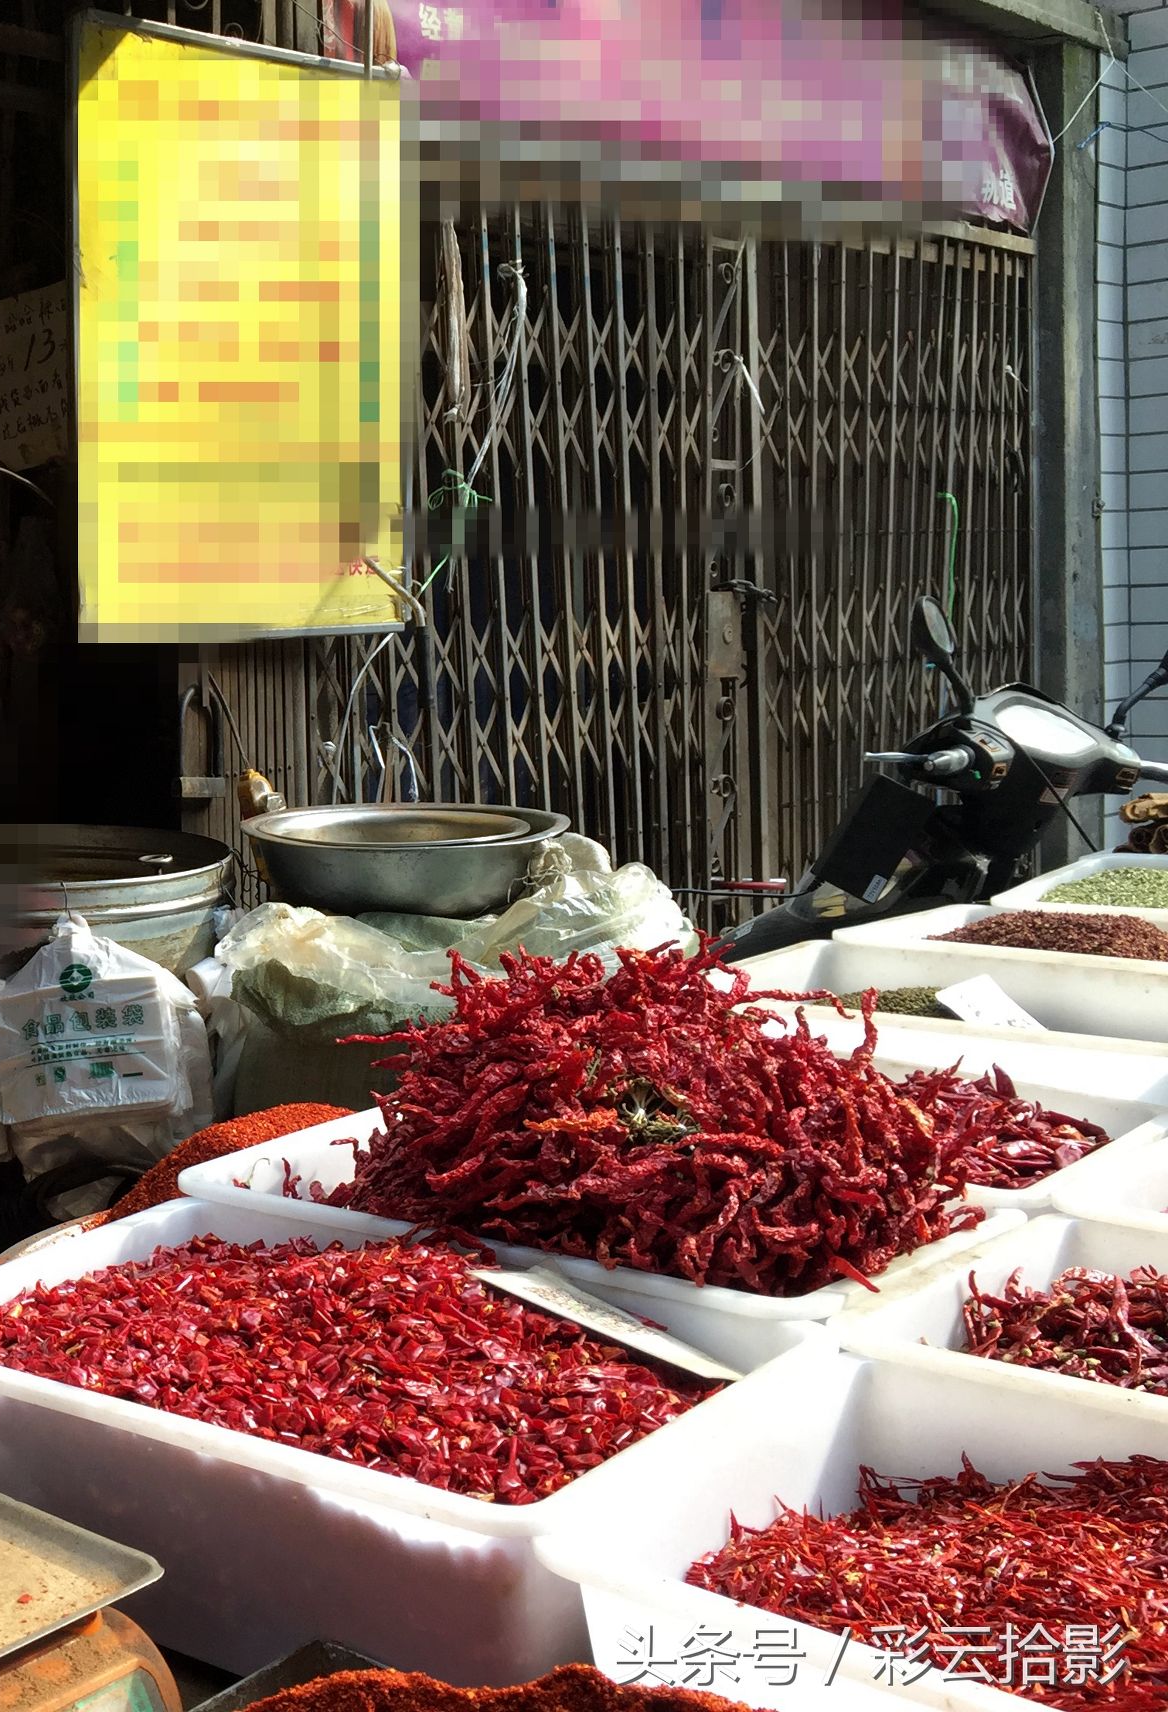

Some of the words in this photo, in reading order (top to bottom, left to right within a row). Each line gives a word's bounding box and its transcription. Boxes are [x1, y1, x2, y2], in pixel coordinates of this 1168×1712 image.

[22, 1004, 144, 1040] 食品包装袋
